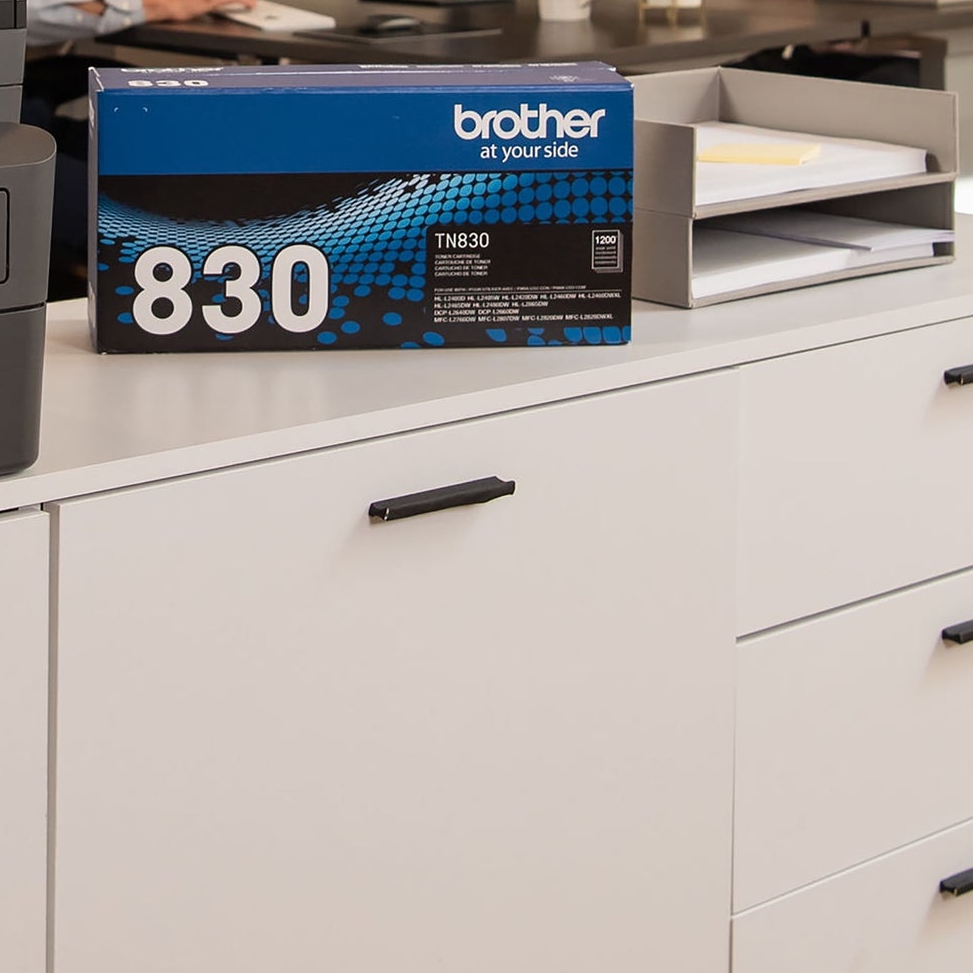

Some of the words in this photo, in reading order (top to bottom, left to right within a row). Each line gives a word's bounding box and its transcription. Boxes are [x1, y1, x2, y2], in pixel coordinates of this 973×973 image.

[454, 103, 606, 140] brother
[480, 145, 498, 159] at
[501, 145, 541, 163] your
[543, 141, 579, 158] side
[434, 232, 490, 249] TN830
[595, 235, 617, 245] 1200
[133, 244, 329, 335] 830
